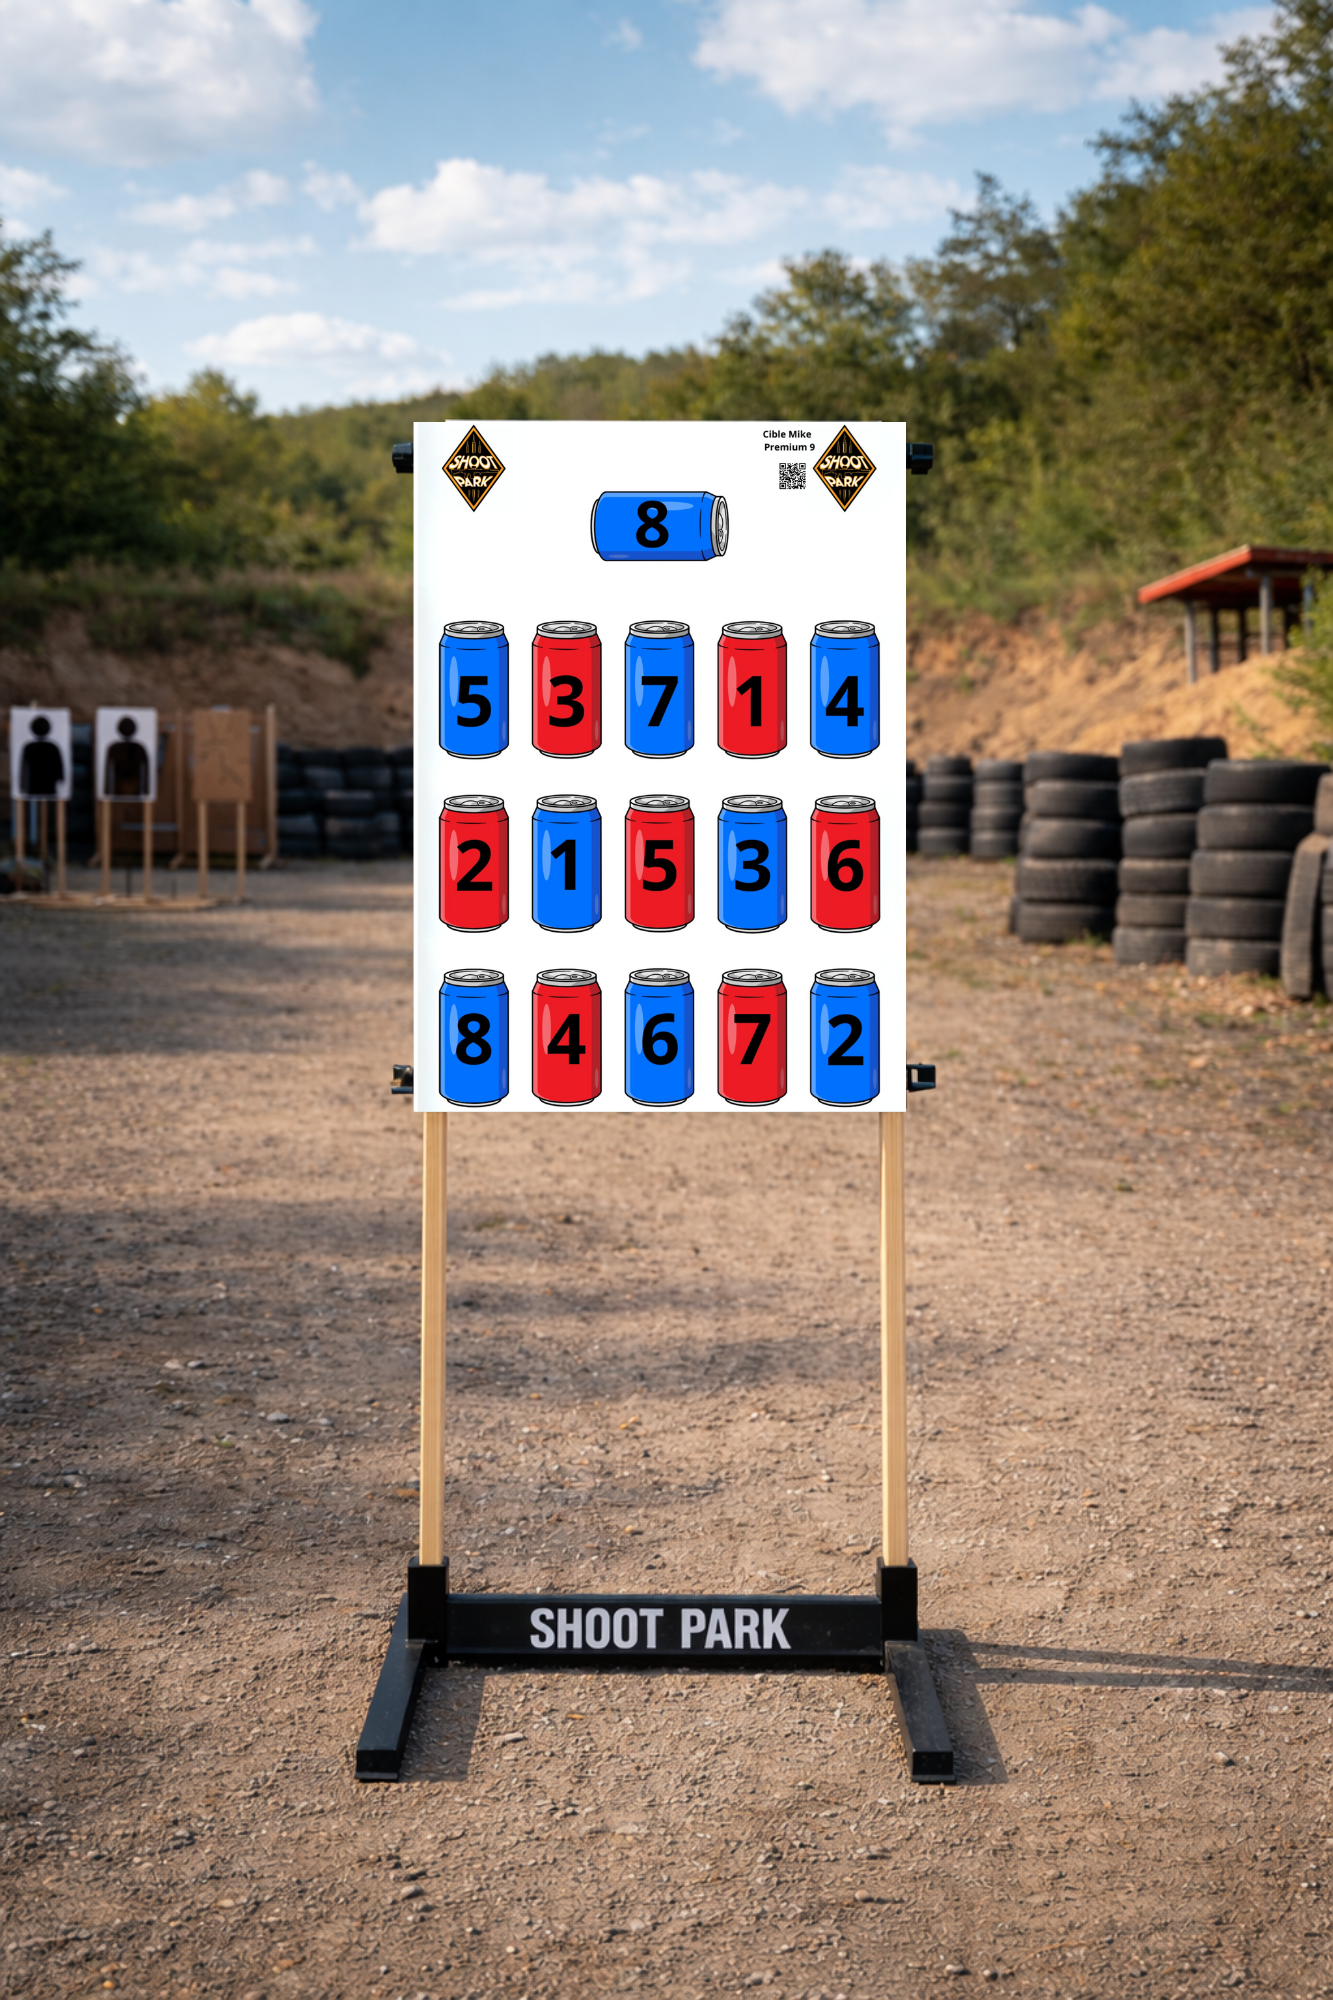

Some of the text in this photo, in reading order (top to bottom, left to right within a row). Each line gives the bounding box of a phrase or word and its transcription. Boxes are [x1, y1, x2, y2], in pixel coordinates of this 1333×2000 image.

[762, 430, 812, 439] Cible Mike
[764, 443, 815, 451] Premium 9
[448, 455, 498, 469] SHOOT
[453, 475, 493, 487] PARK
[819, 455, 869, 469] SHOOT
[824, 475, 864, 487] PARK
[635, 500, 669, 549] 8
[456, 675, 492, 728] 5
[548, 675, 585, 728] 3
[641, 675, 679, 727] 7
[736, 675, 763, 727] 1
[825, 675, 865, 727] 4
[456, 839, 493, 892] 2
[550, 839, 577, 891] 1
[642, 839, 677, 892] 5
[734, 839, 771, 892] 3
[827, 839, 864, 892] 6
[455, 1012, 492, 1066] 8
[547, 1013, 586, 1065] 4
[641, 1012, 679, 1066] 6
[733, 1013, 771, 1065] 7
[826, 1013, 864, 1066] 2
[530, 1607, 792, 1650] SHOOT PARK
